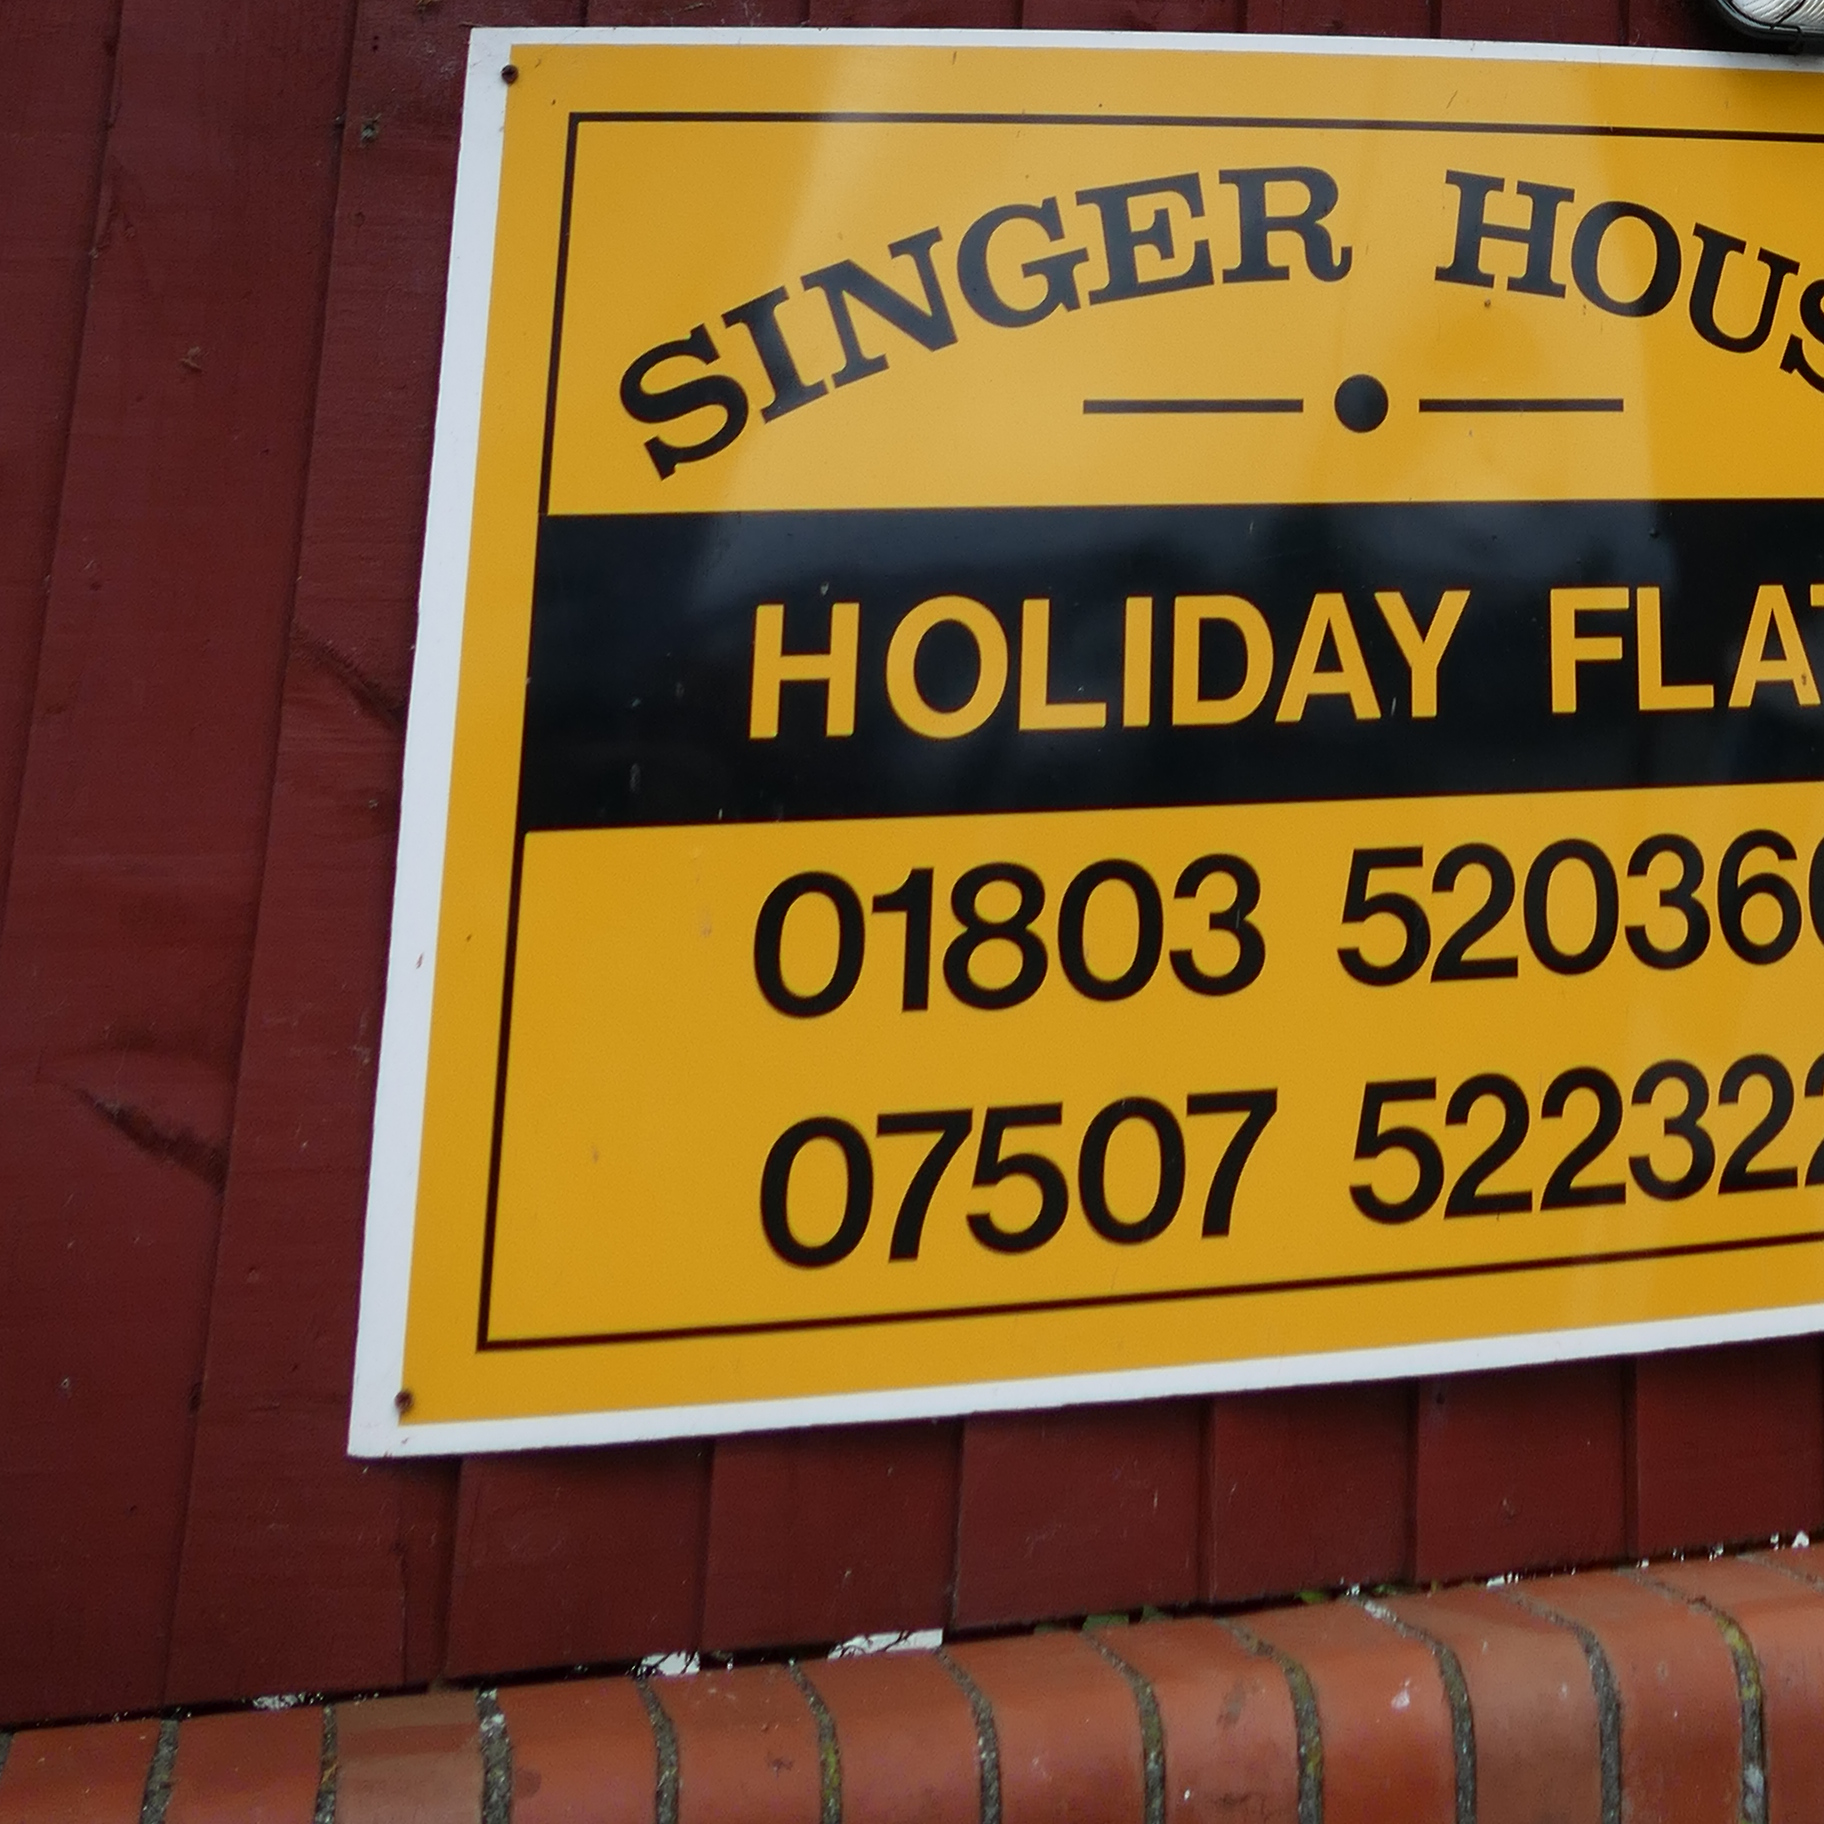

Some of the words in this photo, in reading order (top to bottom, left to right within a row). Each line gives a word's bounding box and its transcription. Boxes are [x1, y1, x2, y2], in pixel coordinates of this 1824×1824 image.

[618, 165, 1354, 482] SINGER
[748, 588, 1472, 741] HOLIDAY
[752, 852, 1267, 1021] 01803
[758, 1087, 1279, 1271] 07507
